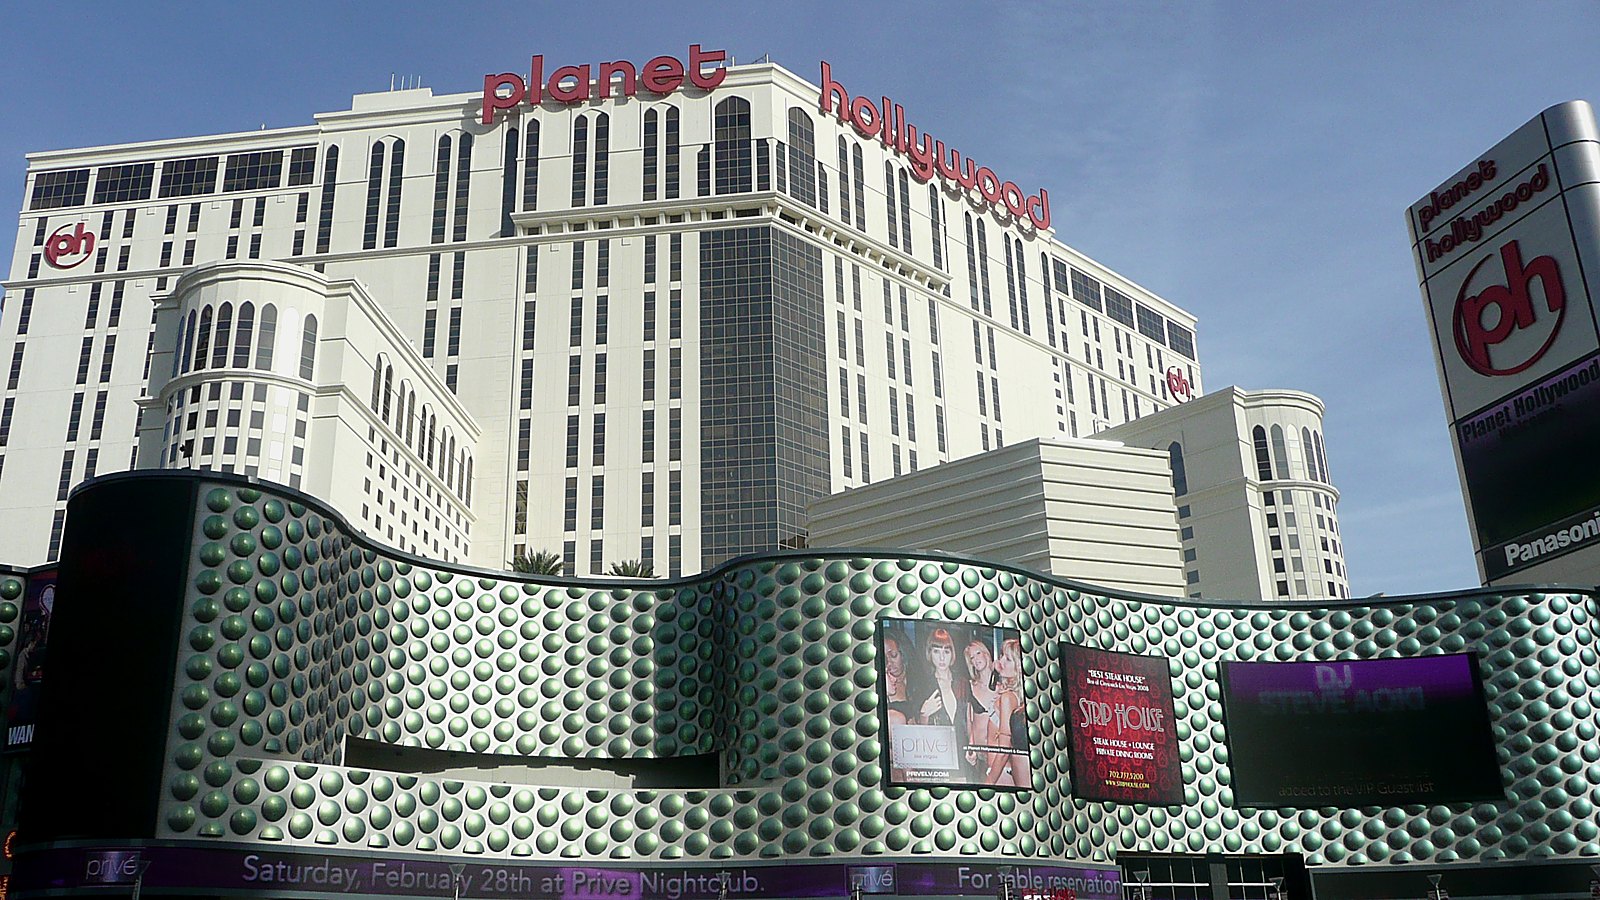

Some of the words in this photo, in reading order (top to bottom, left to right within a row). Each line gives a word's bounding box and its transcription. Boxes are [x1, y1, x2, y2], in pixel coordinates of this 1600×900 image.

[482, 43, 727, 124] planet
[818, 60, 1052, 231] hollywood
[1418, 159, 1497, 233] planet
[1424, 163, 1550, 263] hollywood
[47, 222, 95, 267] ph
[1457, 240, 1566, 372] ph
[1168, 367, 1190, 400] ph
[1462, 405, 1511, 443] Planet
[1514, 358, 1600, 417] Hollywood
[1104, 672, 1122, 681] STEAK
[1314, 664, 1351, 689] DJ
[1078, 697, 1113, 728] STRIP
[1114, 703, 1165, 736] HOUSE
[1093, 737, 1109, 746] STEAK
[1110, 739, 1128, 748] HOUSE
[1132, 741, 1155, 751] LOUNGE
[1134, 751, 1154, 760] ROOMS
[86, 855, 138, 881] privé
[241, 854, 361, 892] Saturday,
[480, 868, 531, 893] 28th
[541, 873, 564, 894] at
[572, 871, 631, 895] Prive
[958, 867, 993, 889] For
[998, 867, 1043, 889] table
[1047, 873, 1121, 895] reservation
